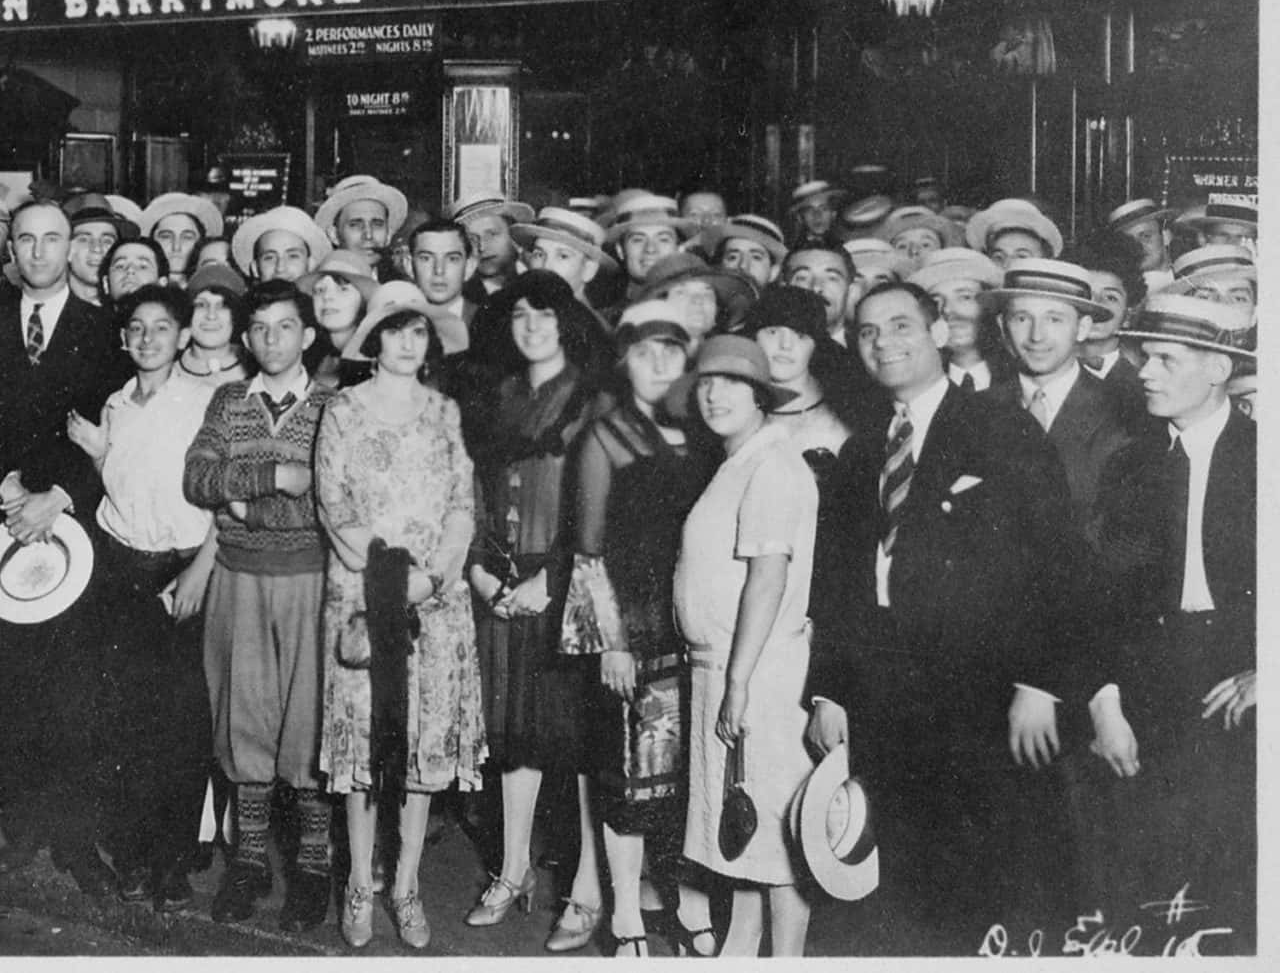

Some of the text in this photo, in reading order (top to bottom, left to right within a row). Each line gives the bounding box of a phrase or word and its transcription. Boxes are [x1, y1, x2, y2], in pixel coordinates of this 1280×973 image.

[305, 21, 435, 42] 2 PERFORMANCES DAILY
[376, 40, 410, 54] NIGHTS
